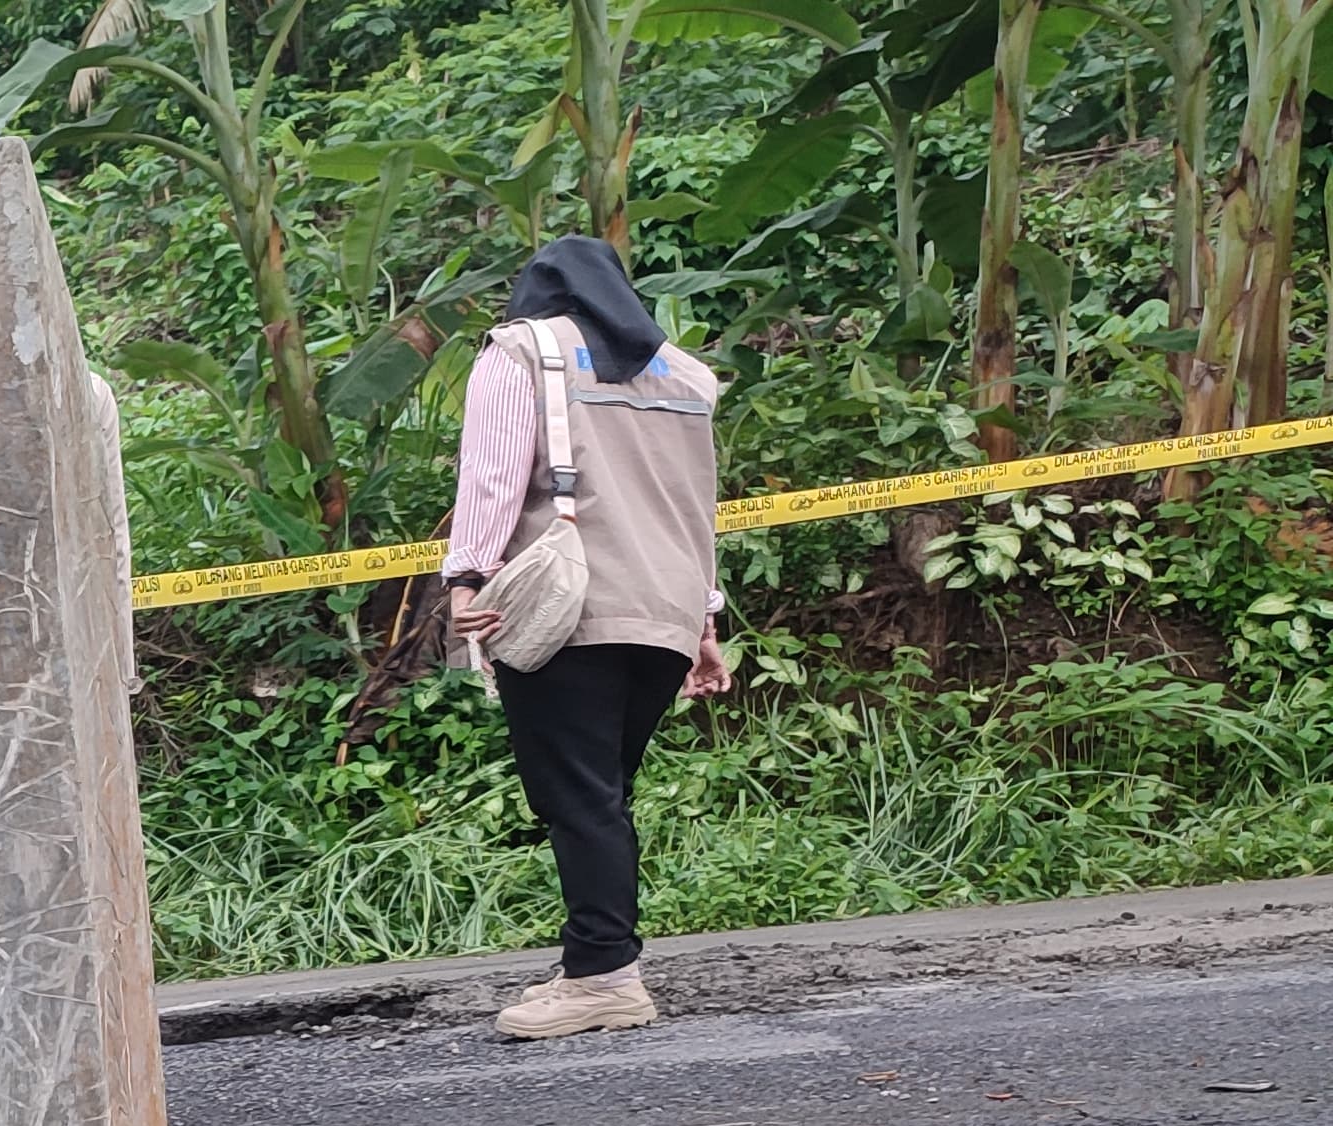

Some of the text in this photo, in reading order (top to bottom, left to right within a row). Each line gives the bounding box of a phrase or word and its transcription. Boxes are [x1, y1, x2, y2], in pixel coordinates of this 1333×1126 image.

[1305, 418, 1333, 431] DILA
[1054, 449, 1112, 468] DILARANG
[1177, 434, 1216, 450] GARIS
[1218, 428, 1255, 445] POLISI
[1197, 443, 1241, 459] POLICE LINE
[934, 468, 968, 485] GARIS
[972, 463, 1007, 480] POLISI
[1084, 459, 1137, 476] DO NOT CROSS
[953, 479, 995, 495] POLICE LINE
[715, 496, 775, 517] ARIS POLISI
[847, 501, 856, 512] DO
[858, 498, 872, 510] NOT
[725, 513, 763, 529] POLICE LINE
[389, 542, 438, 562] DILARANG
[195, 566, 242, 586] DILARANG
[321, 553, 352, 570] POLISI
